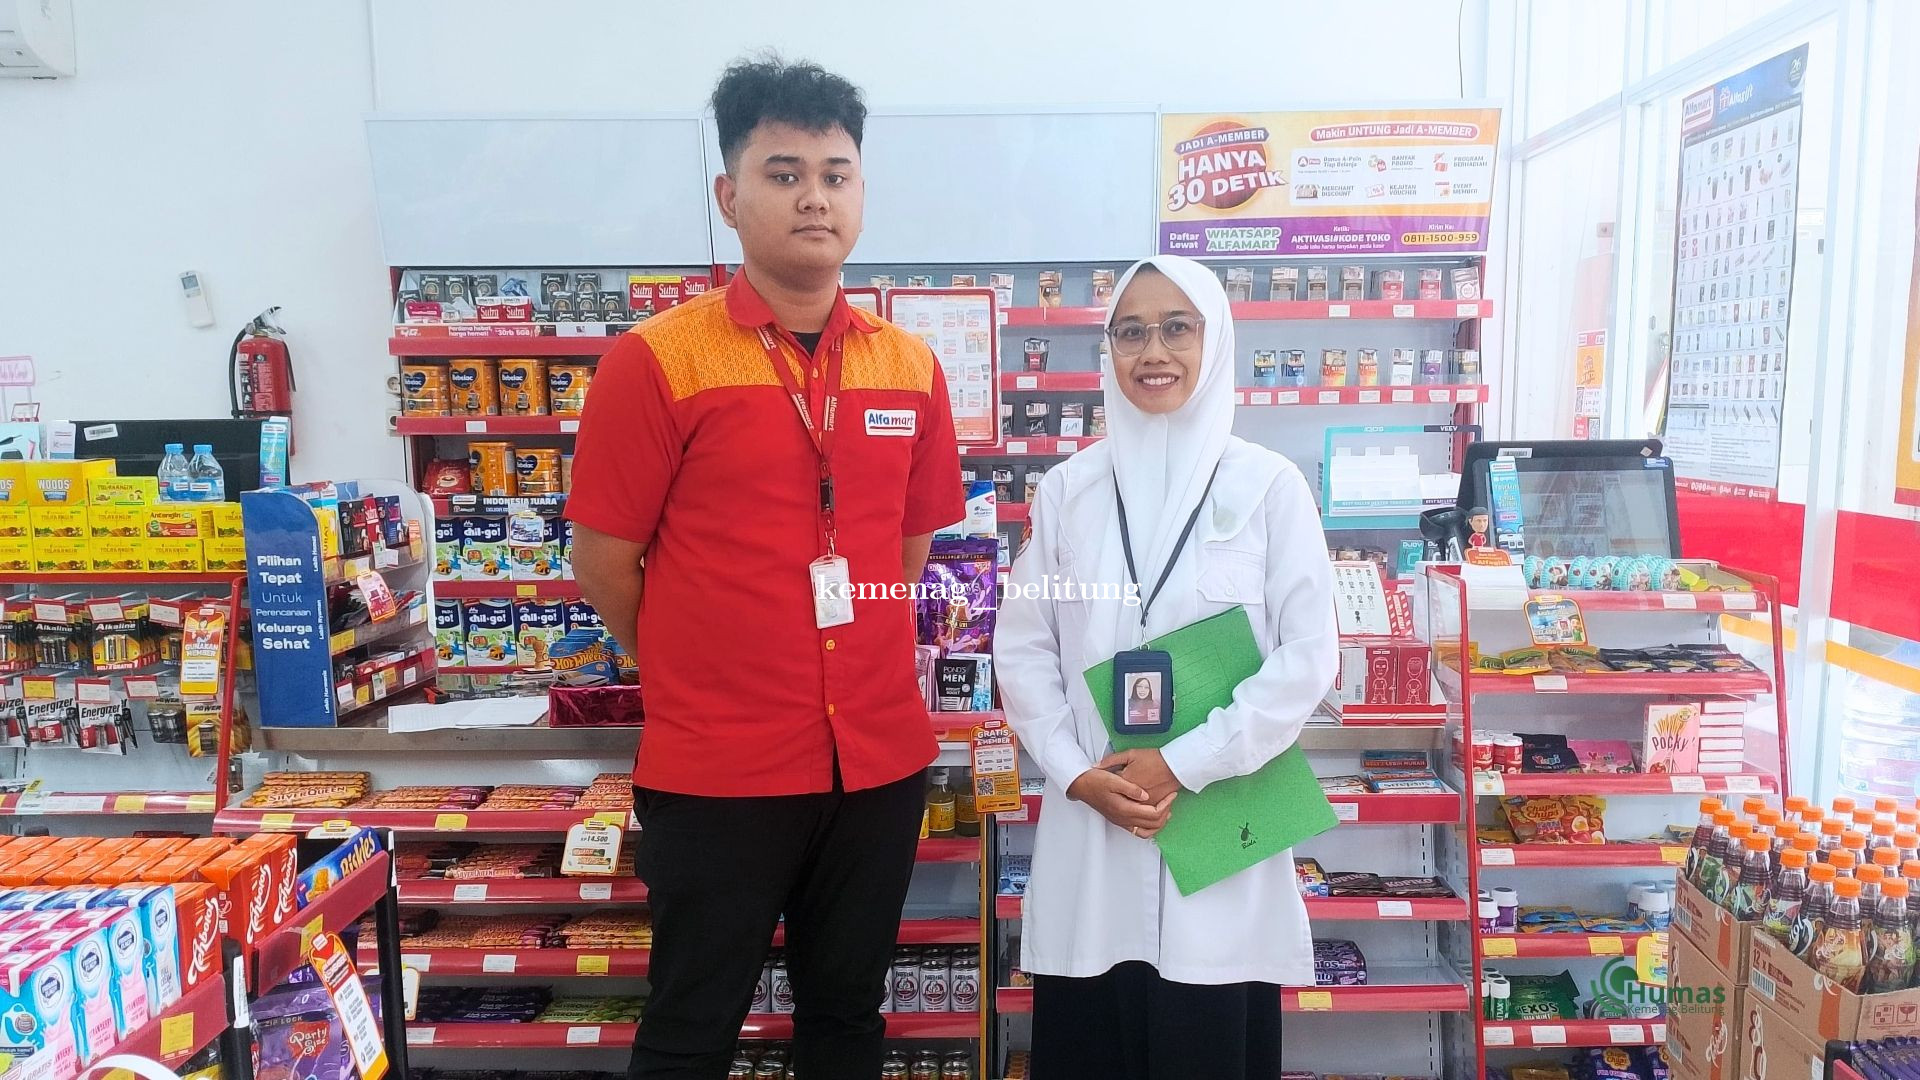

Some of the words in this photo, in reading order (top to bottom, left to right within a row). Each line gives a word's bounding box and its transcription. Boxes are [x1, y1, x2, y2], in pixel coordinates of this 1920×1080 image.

[1316, 127, 1346, 140] Makin
[1348, 124, 1391, 136] UNTUNG
[1392, 123, 1414, 134] Jadi
[1416, 123, 1473, 137] A-MEMBER
[1179, 140, 1204, 153] JADI
[1206, 129, 1265, 146] A-MEMBER
[1178, 150, 1267, 183] HANYA
[1167, 178, 1206, 212] 30
[1212, 171, 1289, 197] DETIK
[1169, 232, 1199, 242] Daftar
[1206, 226, 1281, 241] WHATSAPP
[1364, 232, 1391, 242] TOKO
[1403, 233, 1478, 244] 0811-1500-959
[1169, 240, 1199, 250] Lewat
[1206, 238, 1279, 251] ALFAMART
[633, 284, 653, 296] Sutra
[659, 284, 679, 296] Sutra
[685, 280, 705, 292] Sutra
[481, 307, 499, 317] Sutra
[507, 307, 525, 317] Sutra
[868, 412, 915, 427] Alfamart
[37, 479, 71, 490] WOODS
[483, 497, 529, 505] INDONESIA
[530, 497, 557, 505] JUARA
[150, 512, 180, 520] Antangin
[257, 555, 301, 566] Pilihan
[259, 572, 303, 586] Tepat
[262, 592, 303, 604] Untuk
[256, 608, 312, 617] Perencanaan
[36, 624, 72, 632] Alkaline
[96, 623, 136, 631] Alkaline
[257, 623, 312, 634] Keluarga
[263, 638, 310, 650] Sehat
[944, 666, 966, 674] POND'S
[943, 674, 966, 683] MEN
[28, 698, 73, 715] Energizer
[81, 704, 120, 718] Energizer
[977, 729, 1009, 739] GRATIS
[977, 737, 1010, 746] A-MEMBER
[1526, 804, 1556, 814] Chupa
[1527, 810, 1559, 820] Chups
[1385, 878, 1434, 888] KOPIKO
[1516, 1003, 1557, 1013] HEXOS
[281, 1016, 303, 1025] LOCK
[290, 1028, 327, 1049] Party
[305, 1039, 326, 1055] Size
